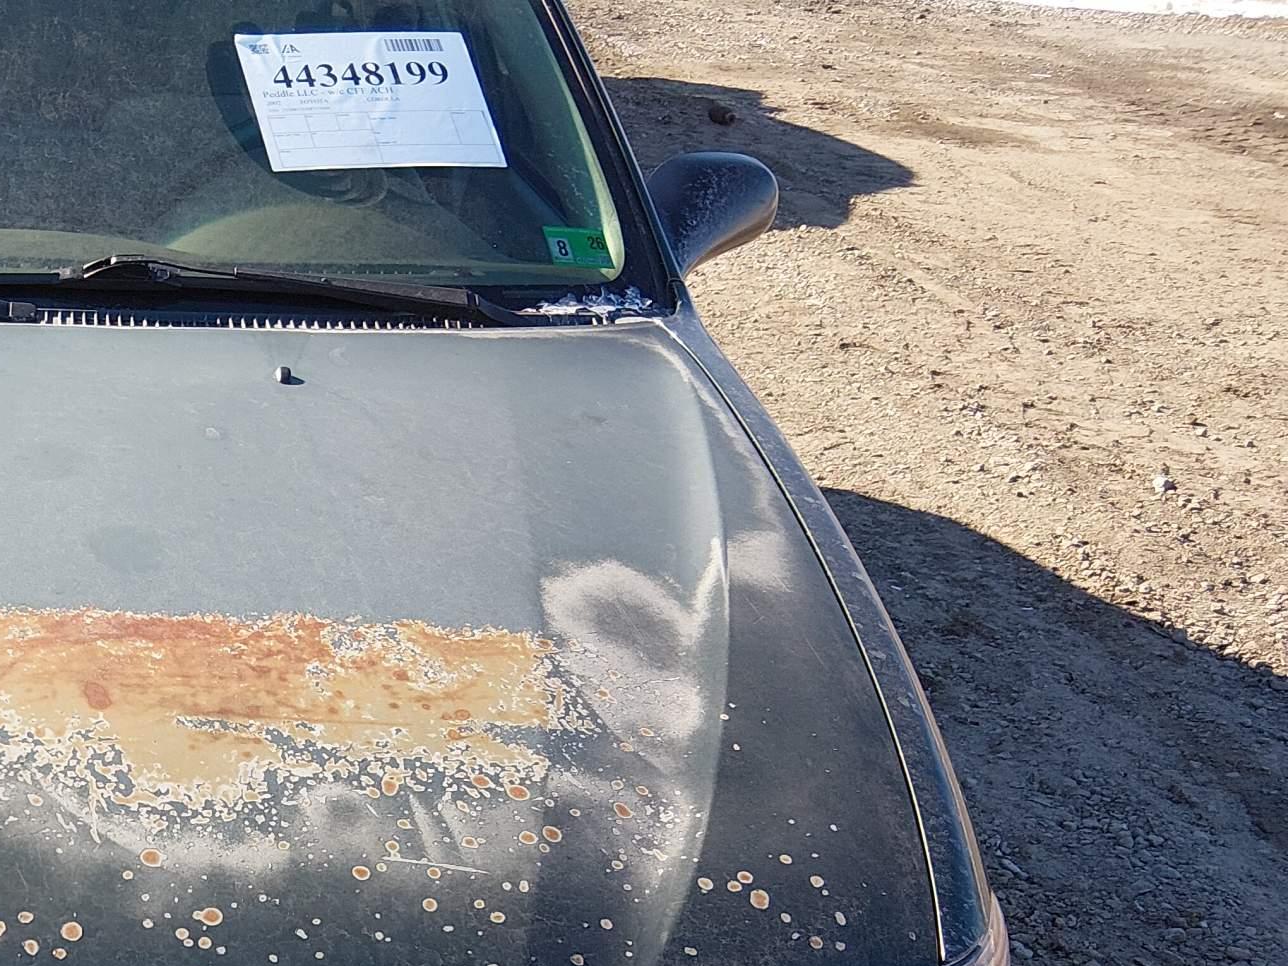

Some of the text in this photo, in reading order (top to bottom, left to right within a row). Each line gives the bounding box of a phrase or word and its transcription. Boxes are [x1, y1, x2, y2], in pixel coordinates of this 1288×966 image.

[273, 60, 449, 88] 44348199
[262, 88, 295, 98] Peddle
[297, 88, 319, 97] LLC
[556, 239, 569, 257] 8
[586, 236, 605, 250] 26
